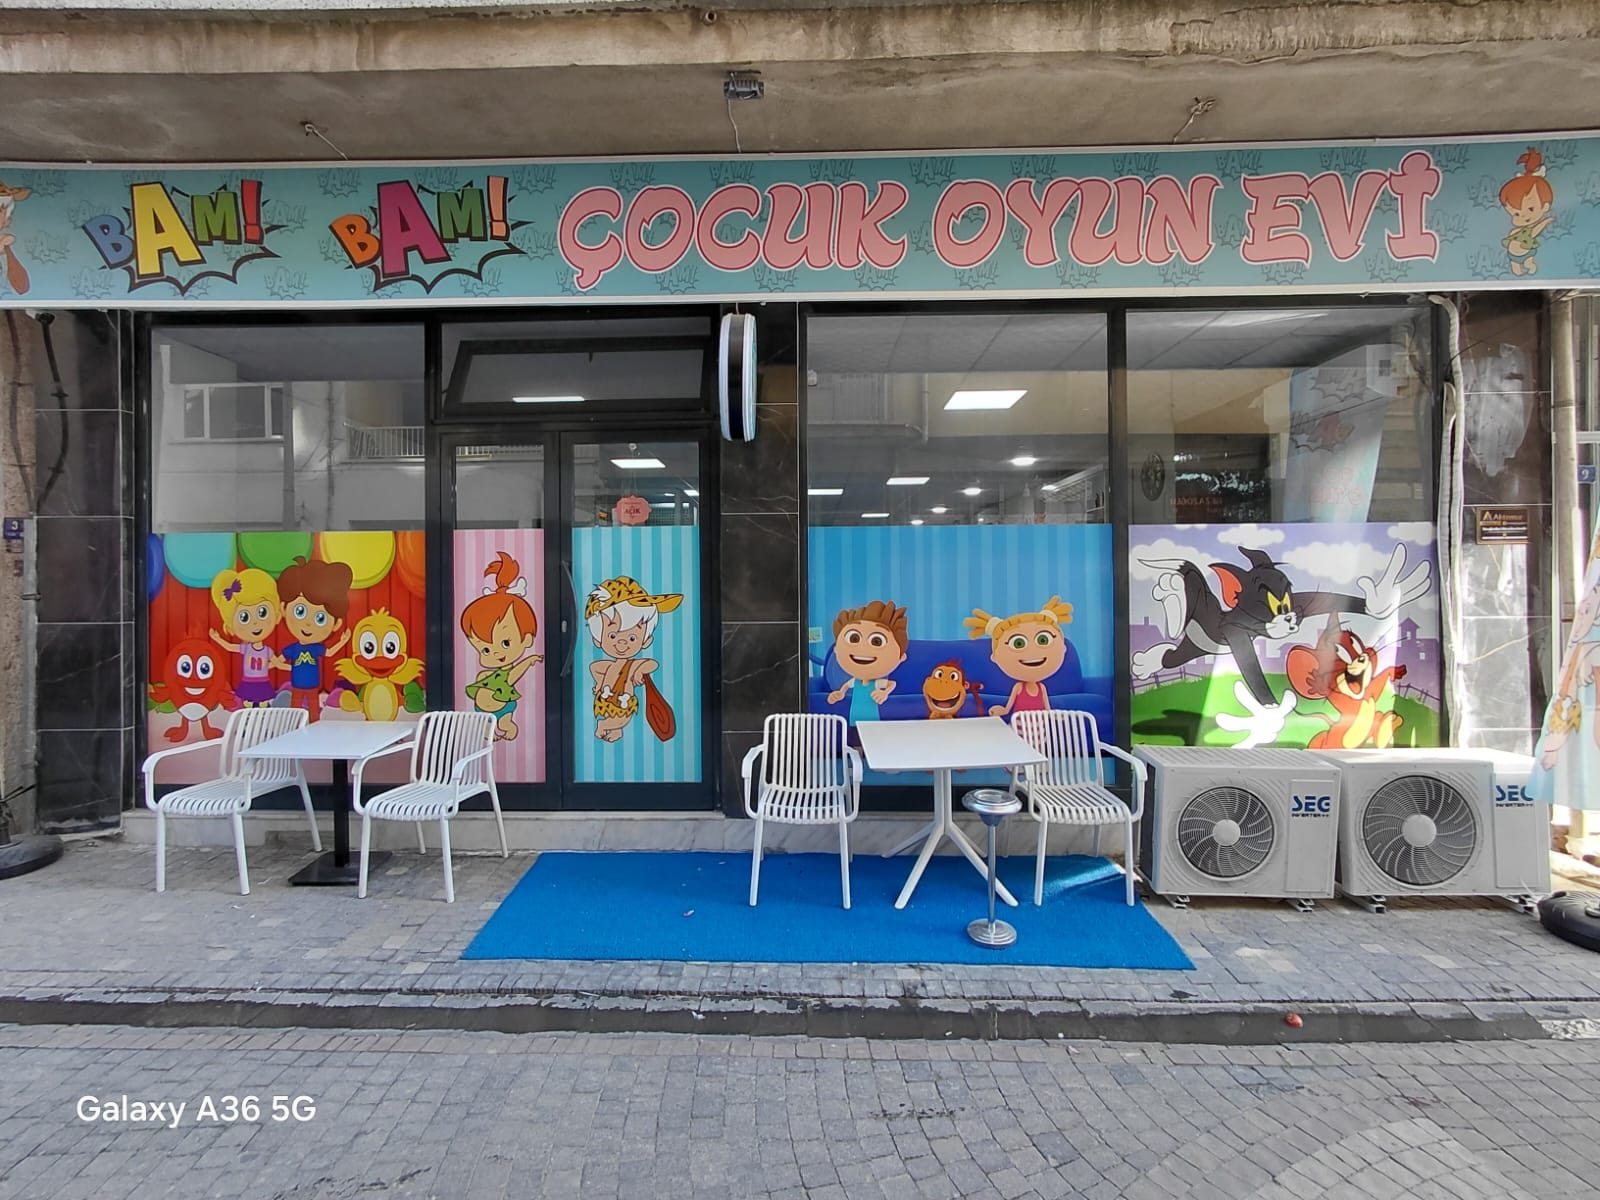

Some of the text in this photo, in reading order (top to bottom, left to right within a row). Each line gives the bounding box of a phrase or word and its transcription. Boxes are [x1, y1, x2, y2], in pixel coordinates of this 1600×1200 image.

[81, 149, 1442, 291] BAM! BAM! ÇOCUK OYUN EVİ
[11, 520, 19, 531] 3
[1291, 795, 1331, 813] SEG
